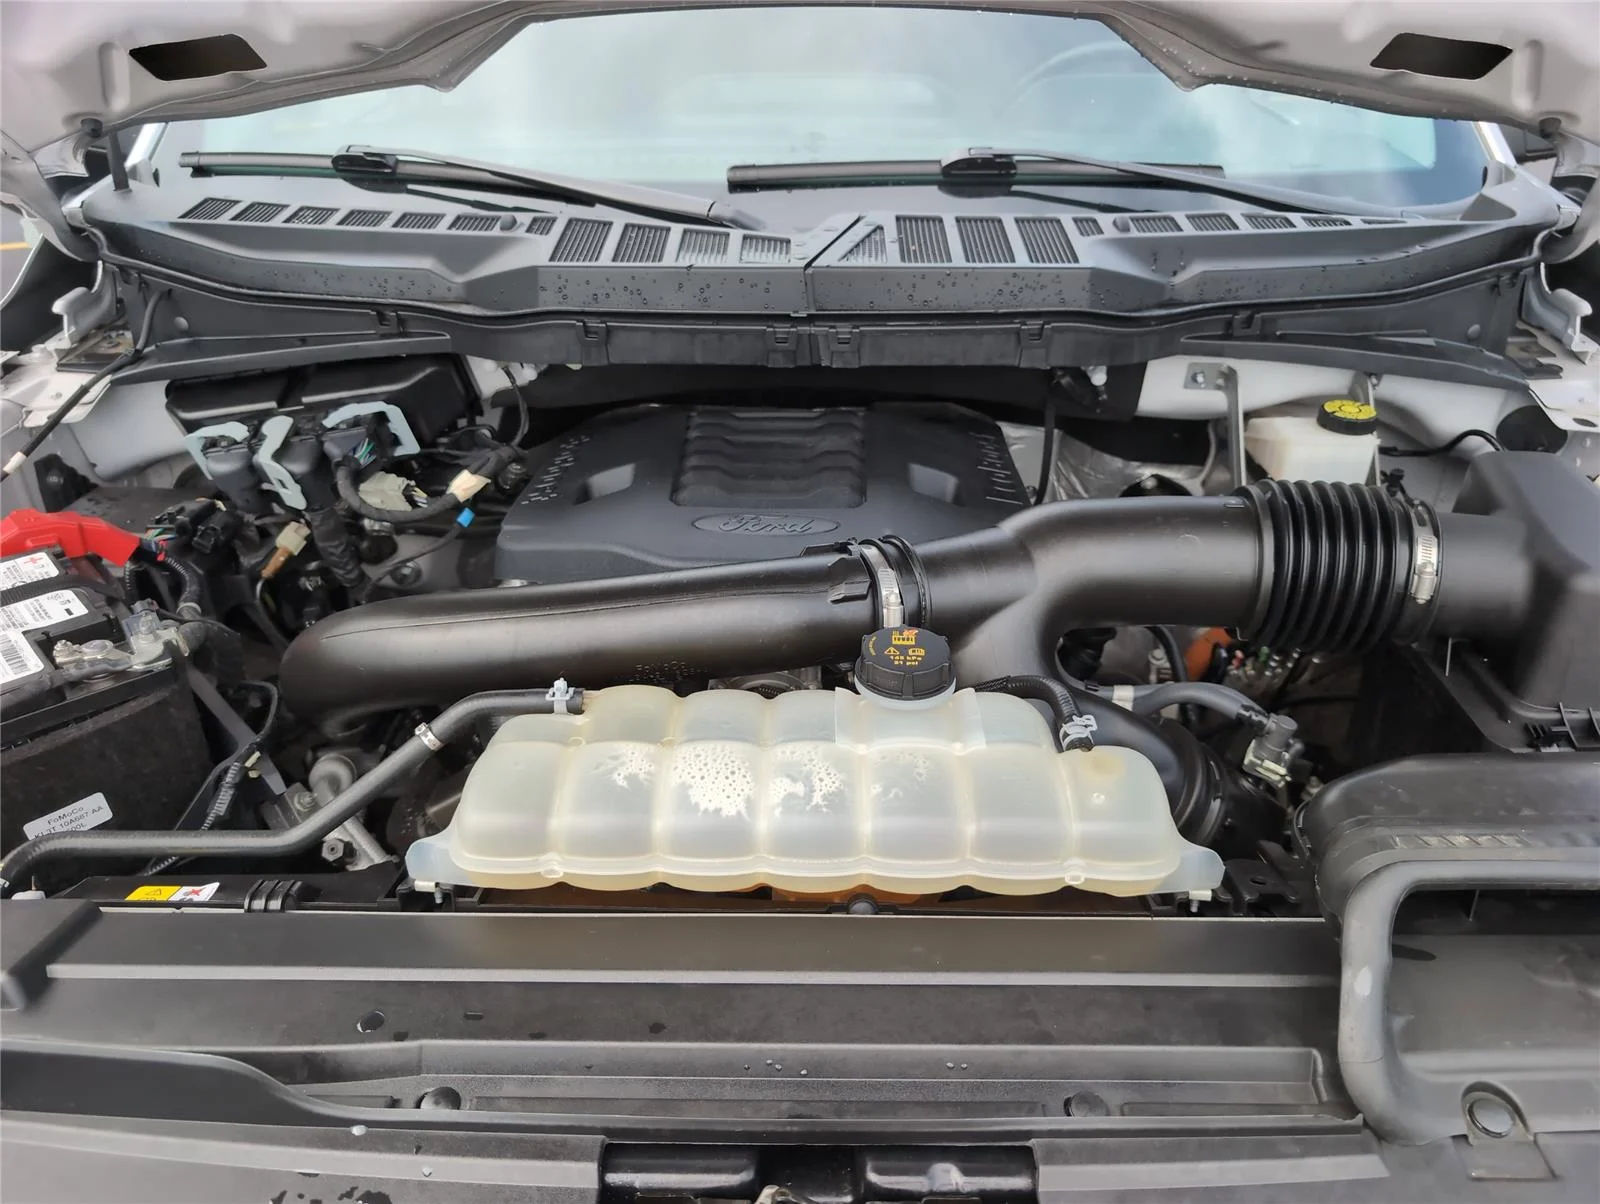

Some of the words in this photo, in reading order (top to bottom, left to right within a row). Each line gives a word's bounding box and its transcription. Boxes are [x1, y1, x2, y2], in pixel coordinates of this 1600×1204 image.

[719, 512, 815, 533] Ford
[47, 806, 84, 825] FoMoCo
[91, 805, 103, 815] AA
